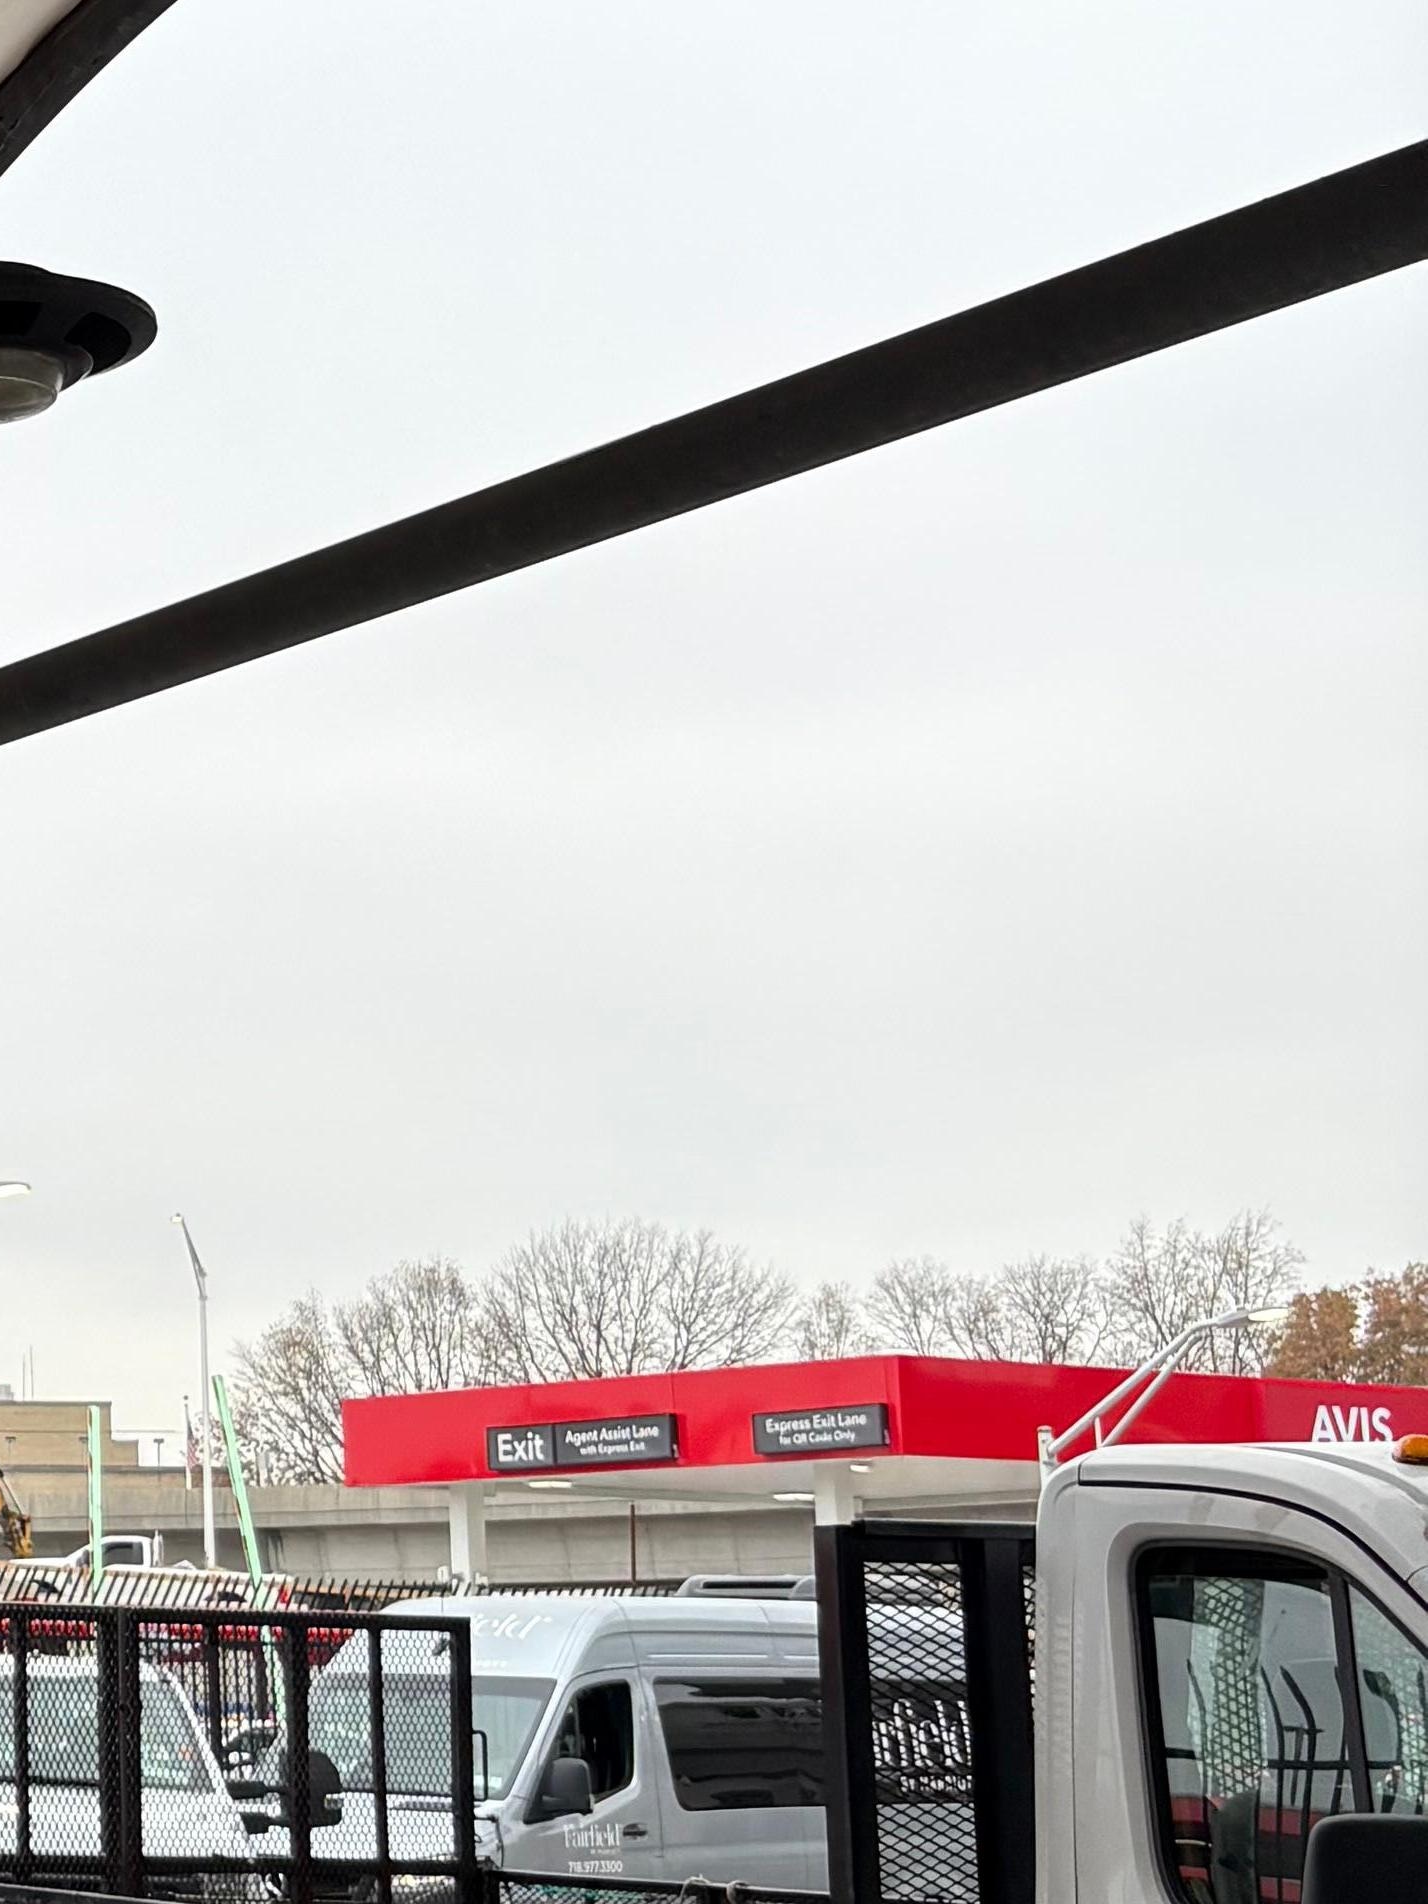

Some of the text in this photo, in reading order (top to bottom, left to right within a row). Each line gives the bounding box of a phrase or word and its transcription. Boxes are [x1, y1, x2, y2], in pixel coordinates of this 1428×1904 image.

[565, 1429, 598, 1446] Agent
[632, 1424, 659, 1438] Lane
[765, 1418, 811, 1434] Express
[837, 1412, 867, 1427] Lane
[1311, 1404, 1394, 1442] AVIS
[497, 1432, 544, 1462] Exit
